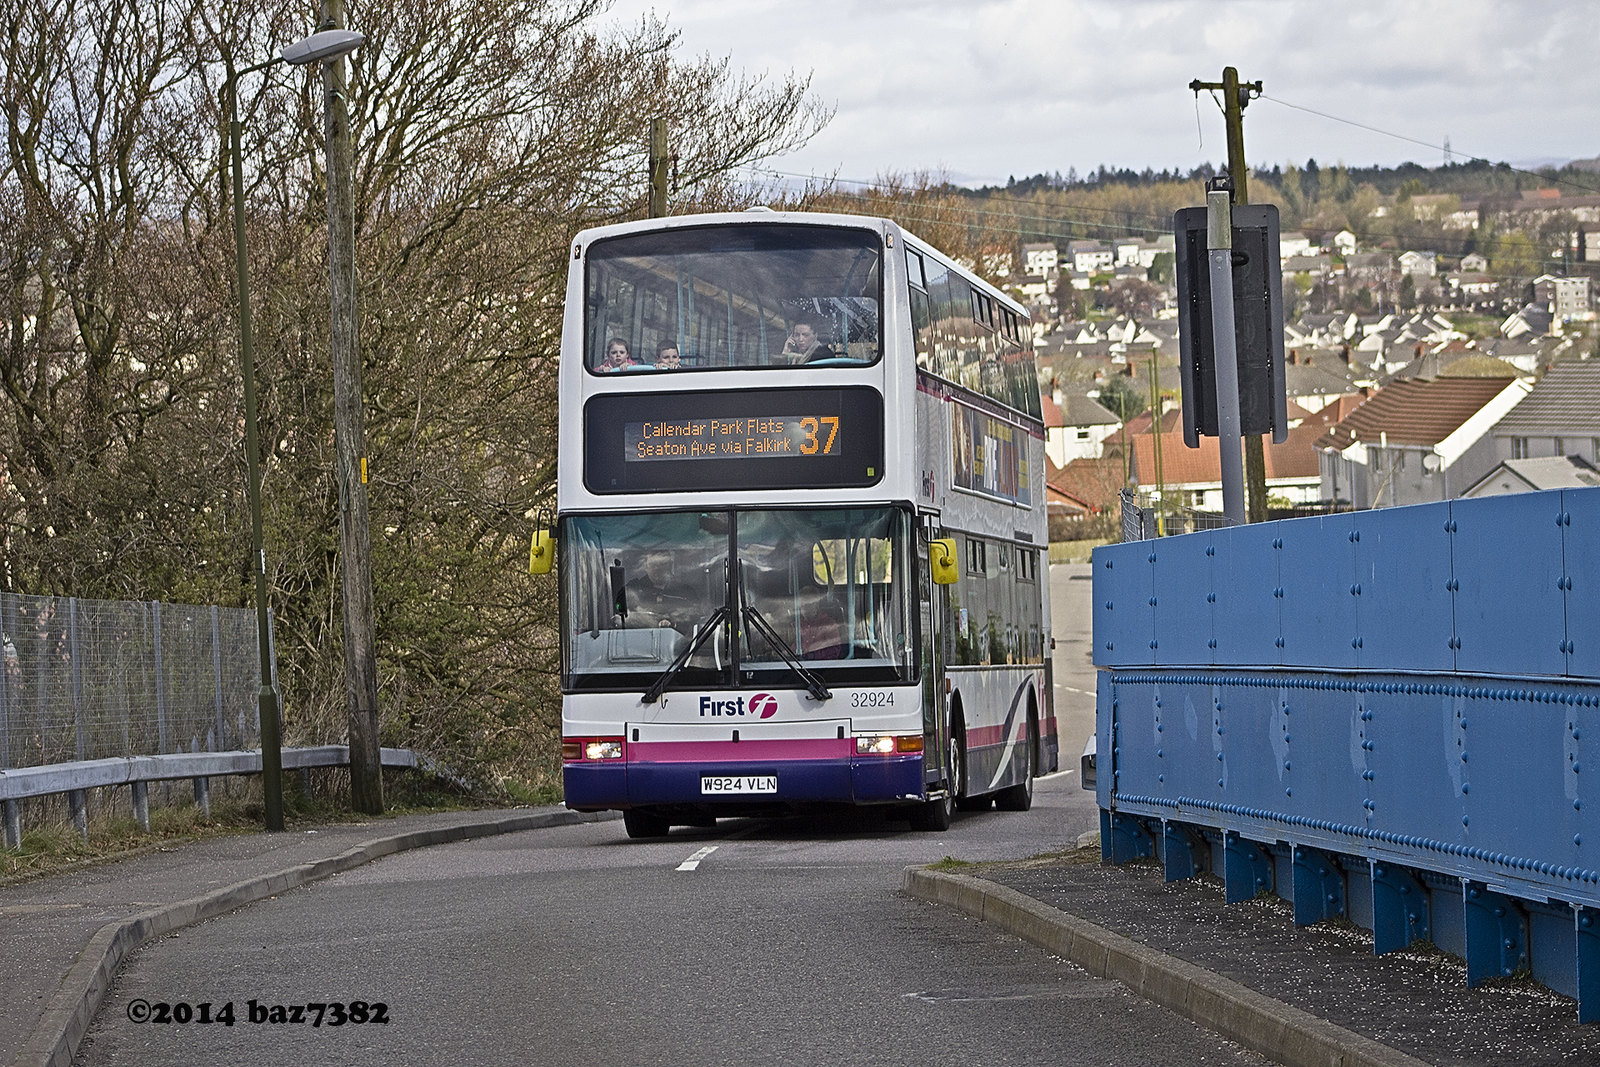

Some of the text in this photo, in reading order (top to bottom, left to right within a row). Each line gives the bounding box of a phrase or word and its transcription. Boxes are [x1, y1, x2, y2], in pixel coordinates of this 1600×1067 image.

[643, 419, 784, 439] Callendar Park Flats
[800, 416, 839, 455] 37
[637, 437, 791, 458] Seaton Ave via Falkirk
[699, 696, 745, 716] First
[850, 691, 894, 708] 32924
[703, 778, 776, 791] W924 VLN
